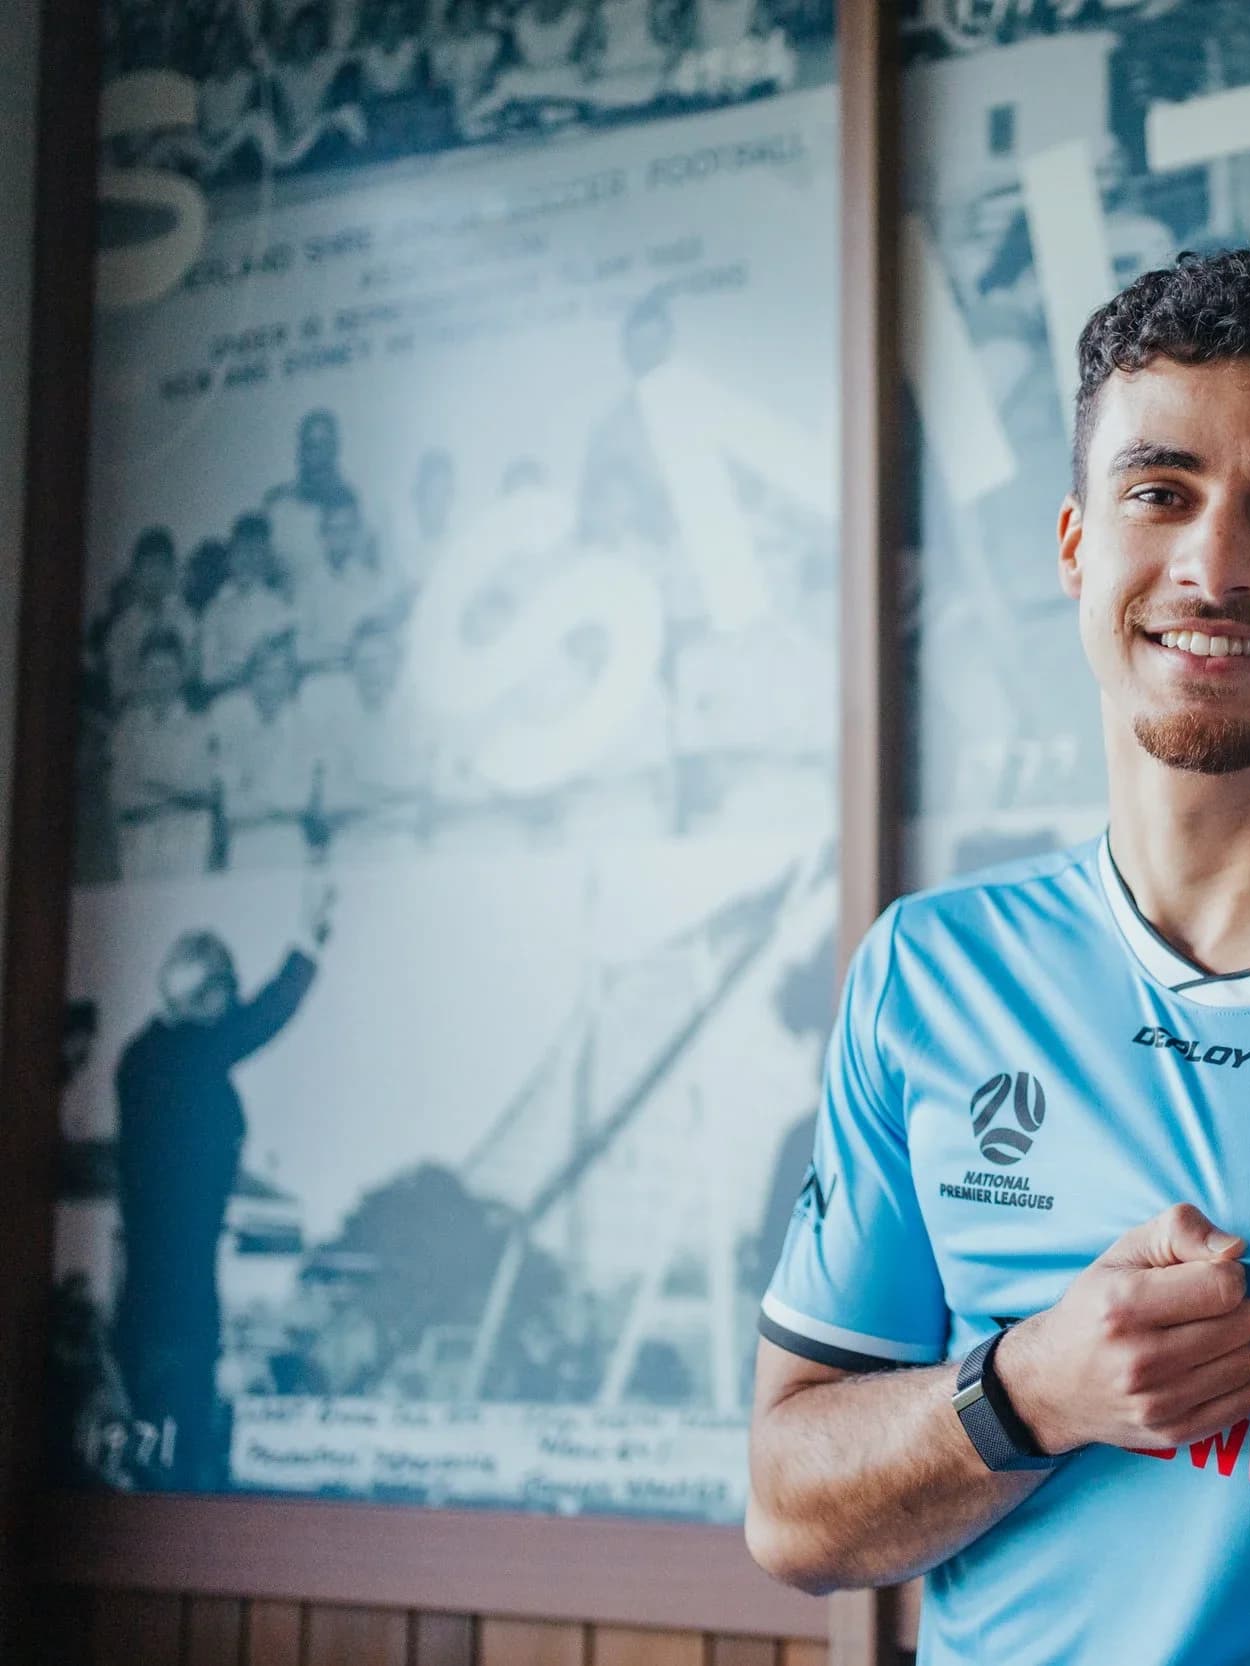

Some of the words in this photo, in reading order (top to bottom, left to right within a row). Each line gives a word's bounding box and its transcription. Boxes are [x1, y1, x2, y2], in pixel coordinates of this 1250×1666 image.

[963, 1170, 1031, 1191] NATIONAL
[939, 1183, 993, 1203] PREMIER
[994, 1190, 1055, 1210] LEAGUES
